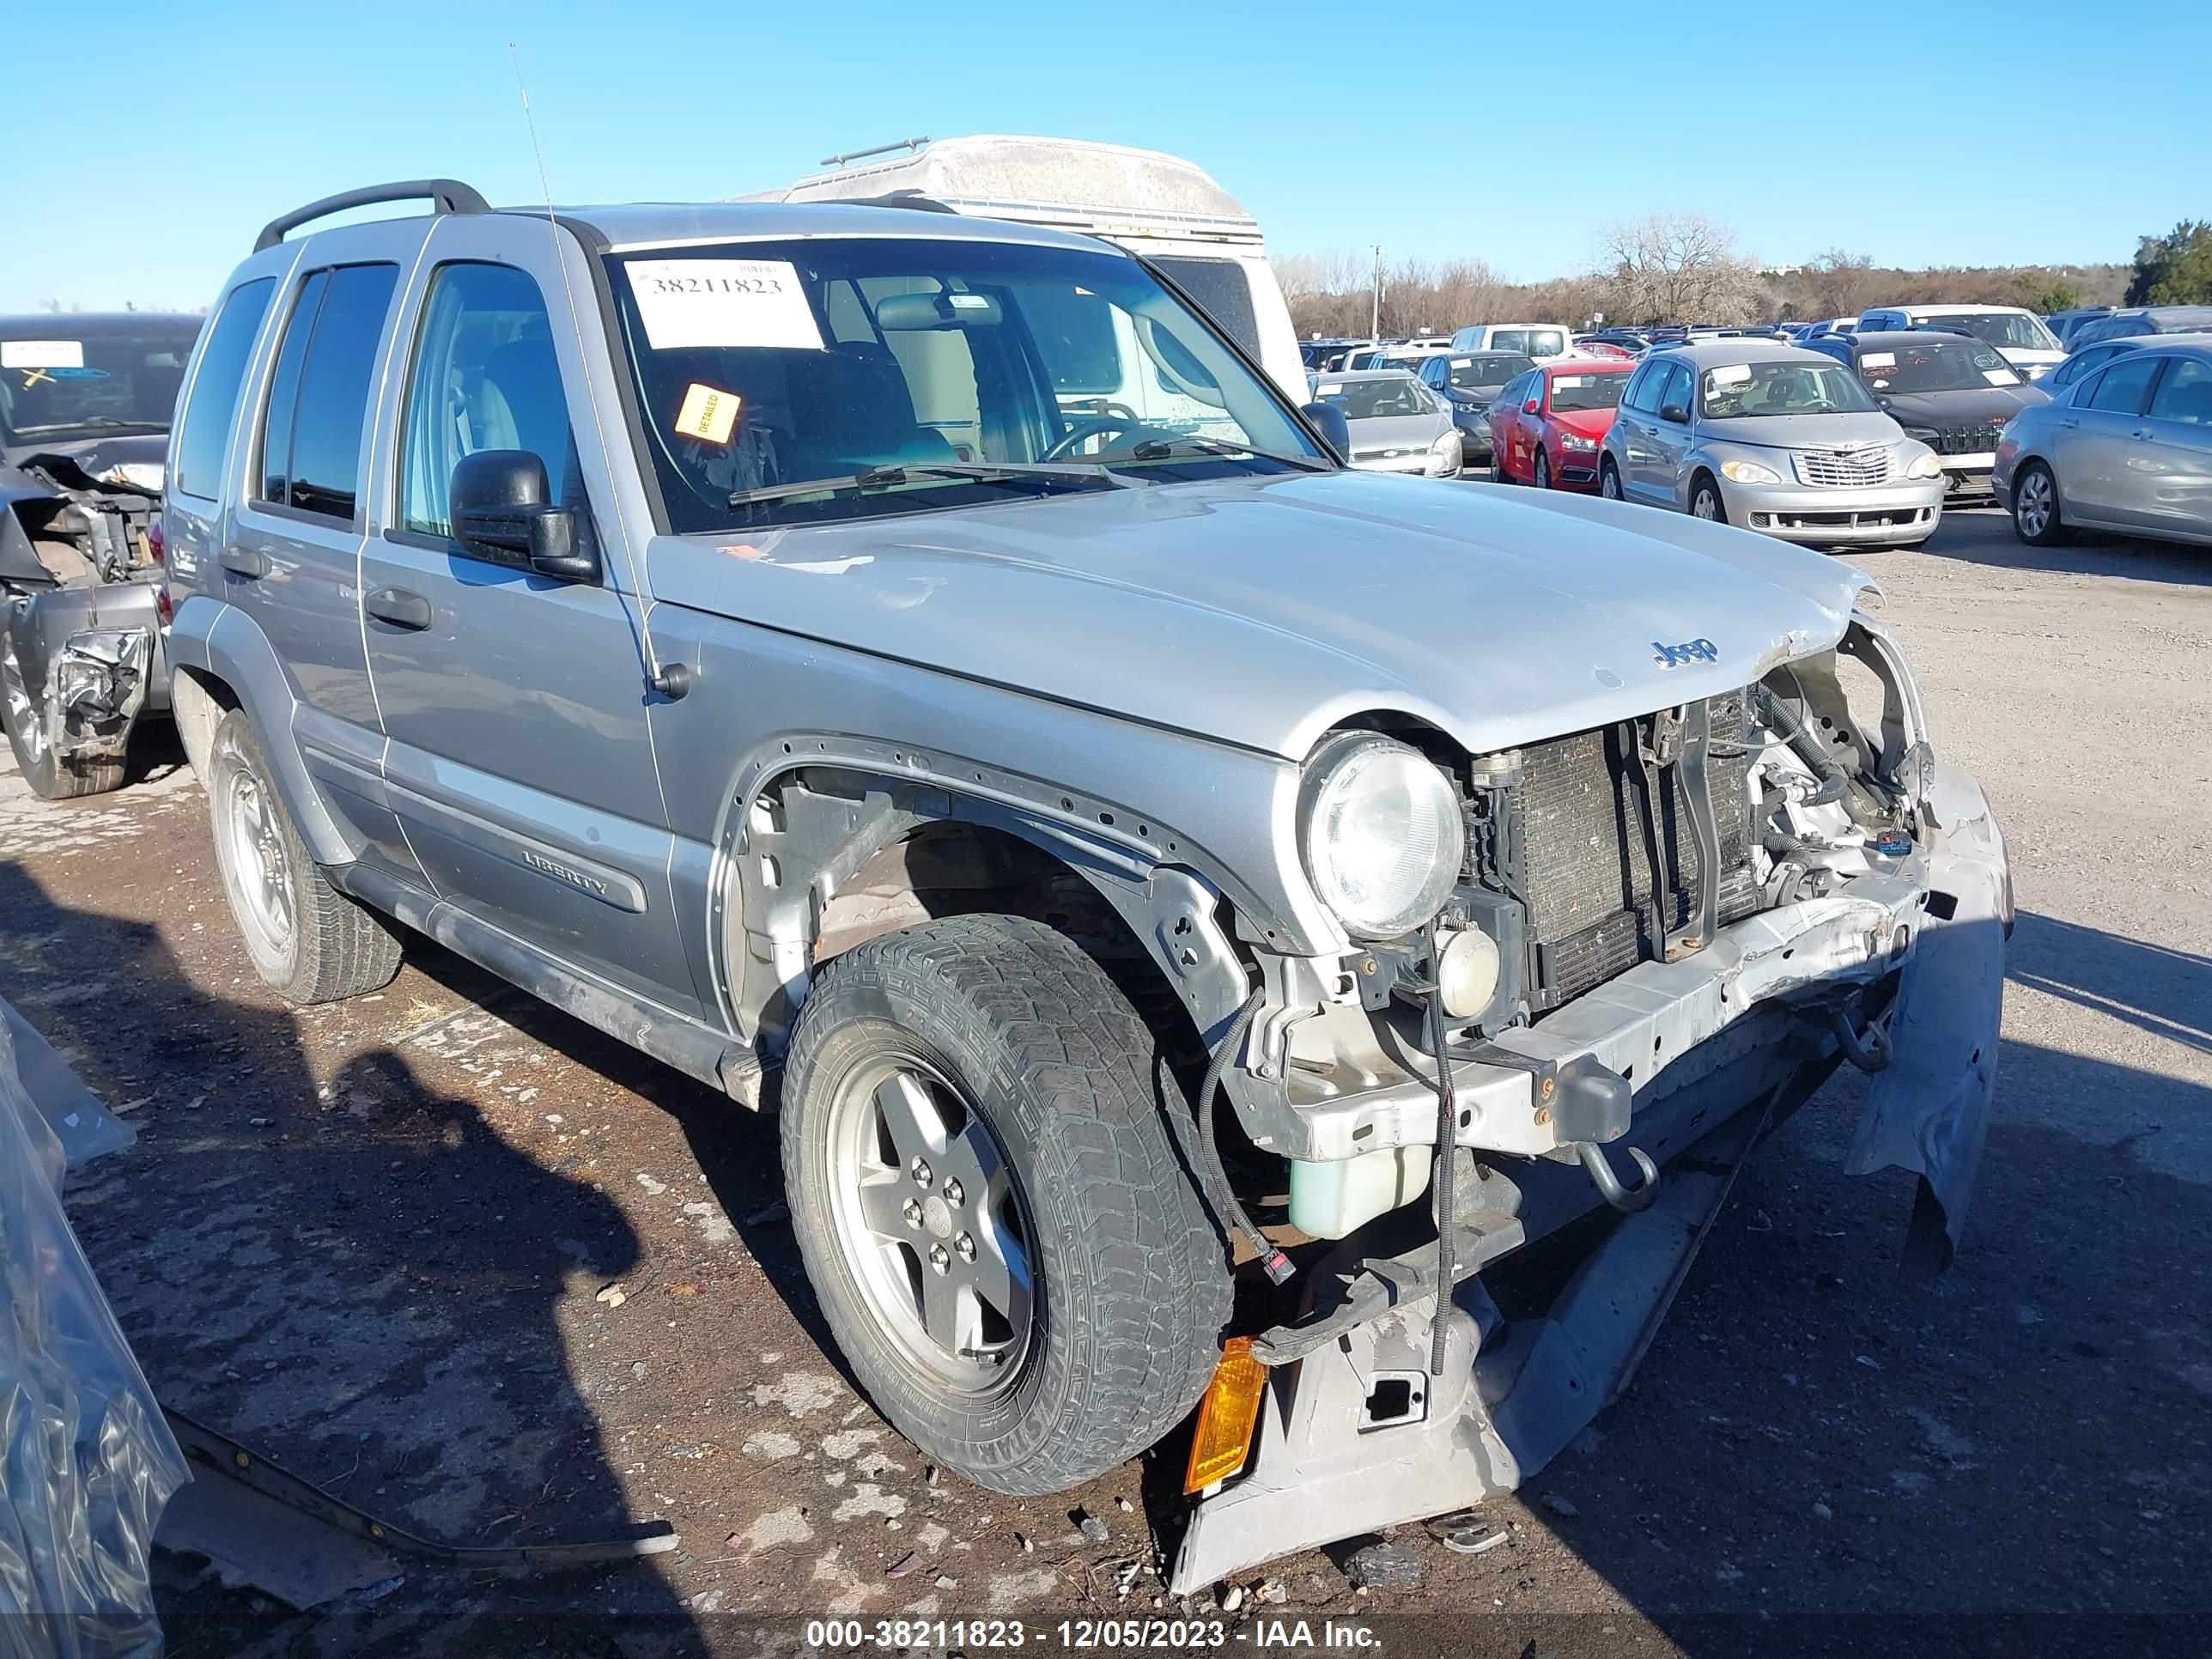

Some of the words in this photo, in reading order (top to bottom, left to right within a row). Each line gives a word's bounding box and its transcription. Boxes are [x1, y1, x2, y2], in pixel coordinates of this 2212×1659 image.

[653, 278, 782, 295] 38211823
[698, 394, 719, 433] DETAILED
[1650, 638, 1718, 670] Jeep
[522, 851, 608, 895] LIBERTY
[781, 1037, 810, 1217] ECOPATH
[976, 1240, 1066, 1468] TRAVELSTAR
